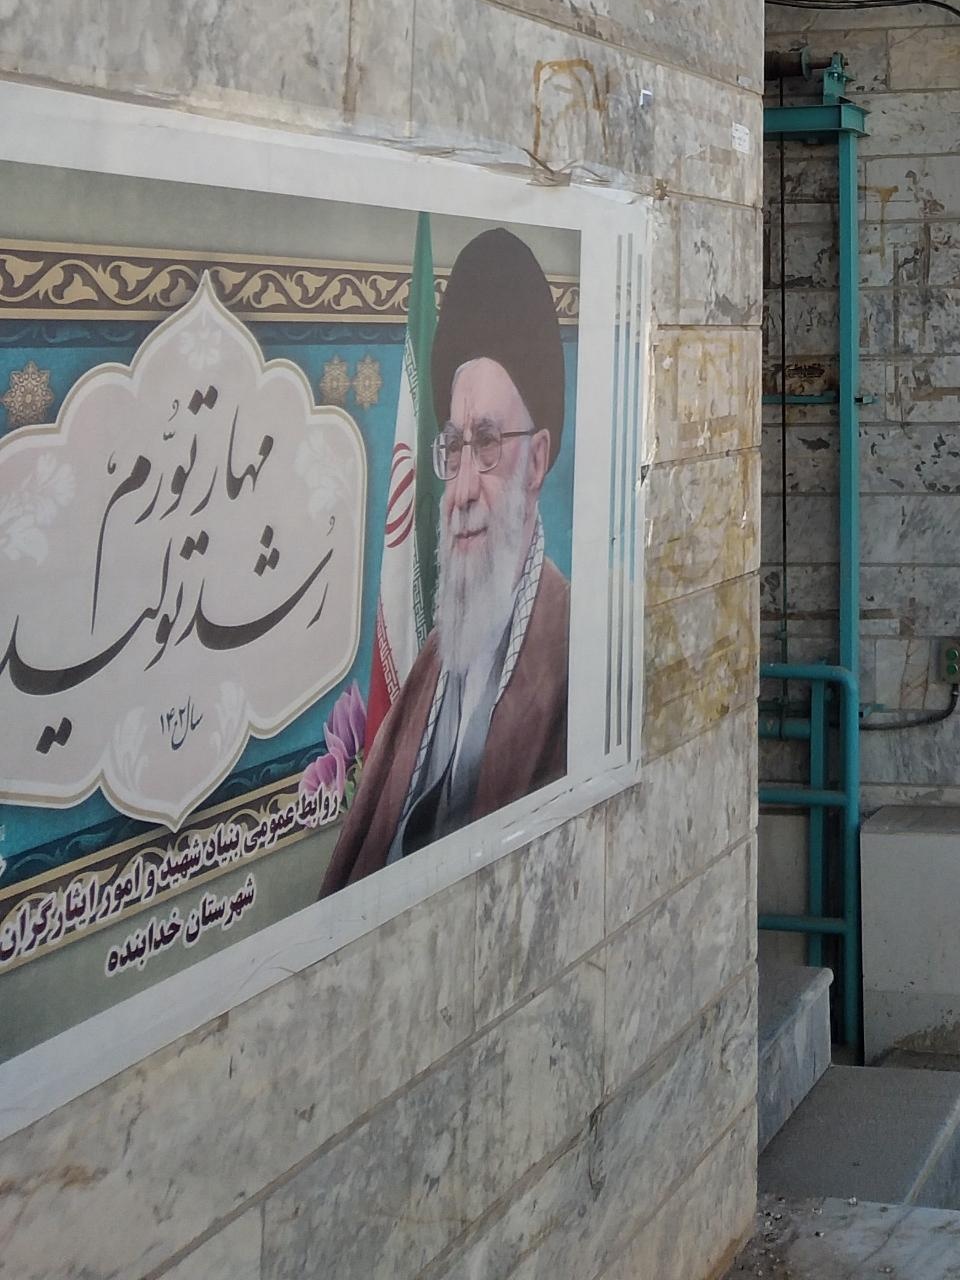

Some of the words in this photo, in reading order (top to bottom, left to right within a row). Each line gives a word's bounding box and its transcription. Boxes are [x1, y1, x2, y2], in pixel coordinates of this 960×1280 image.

[190, 404, 274, 516] مهار
[0, 530, 210, 754] تولید
[243, 807, 296, 854] عمومی
[298, 785, 339, 826] روابط
[160, 839, 202, 887] شهید
[205, 822, 241, 865] بنیاد
[100, 858, 140, 919] امور
[146, 866, 156, 898] و
[185, 878, 255, 943] شهرستان
[0, 878, 97, 962] ایثارگران
[107, 909, 181, 972] خدابنده
